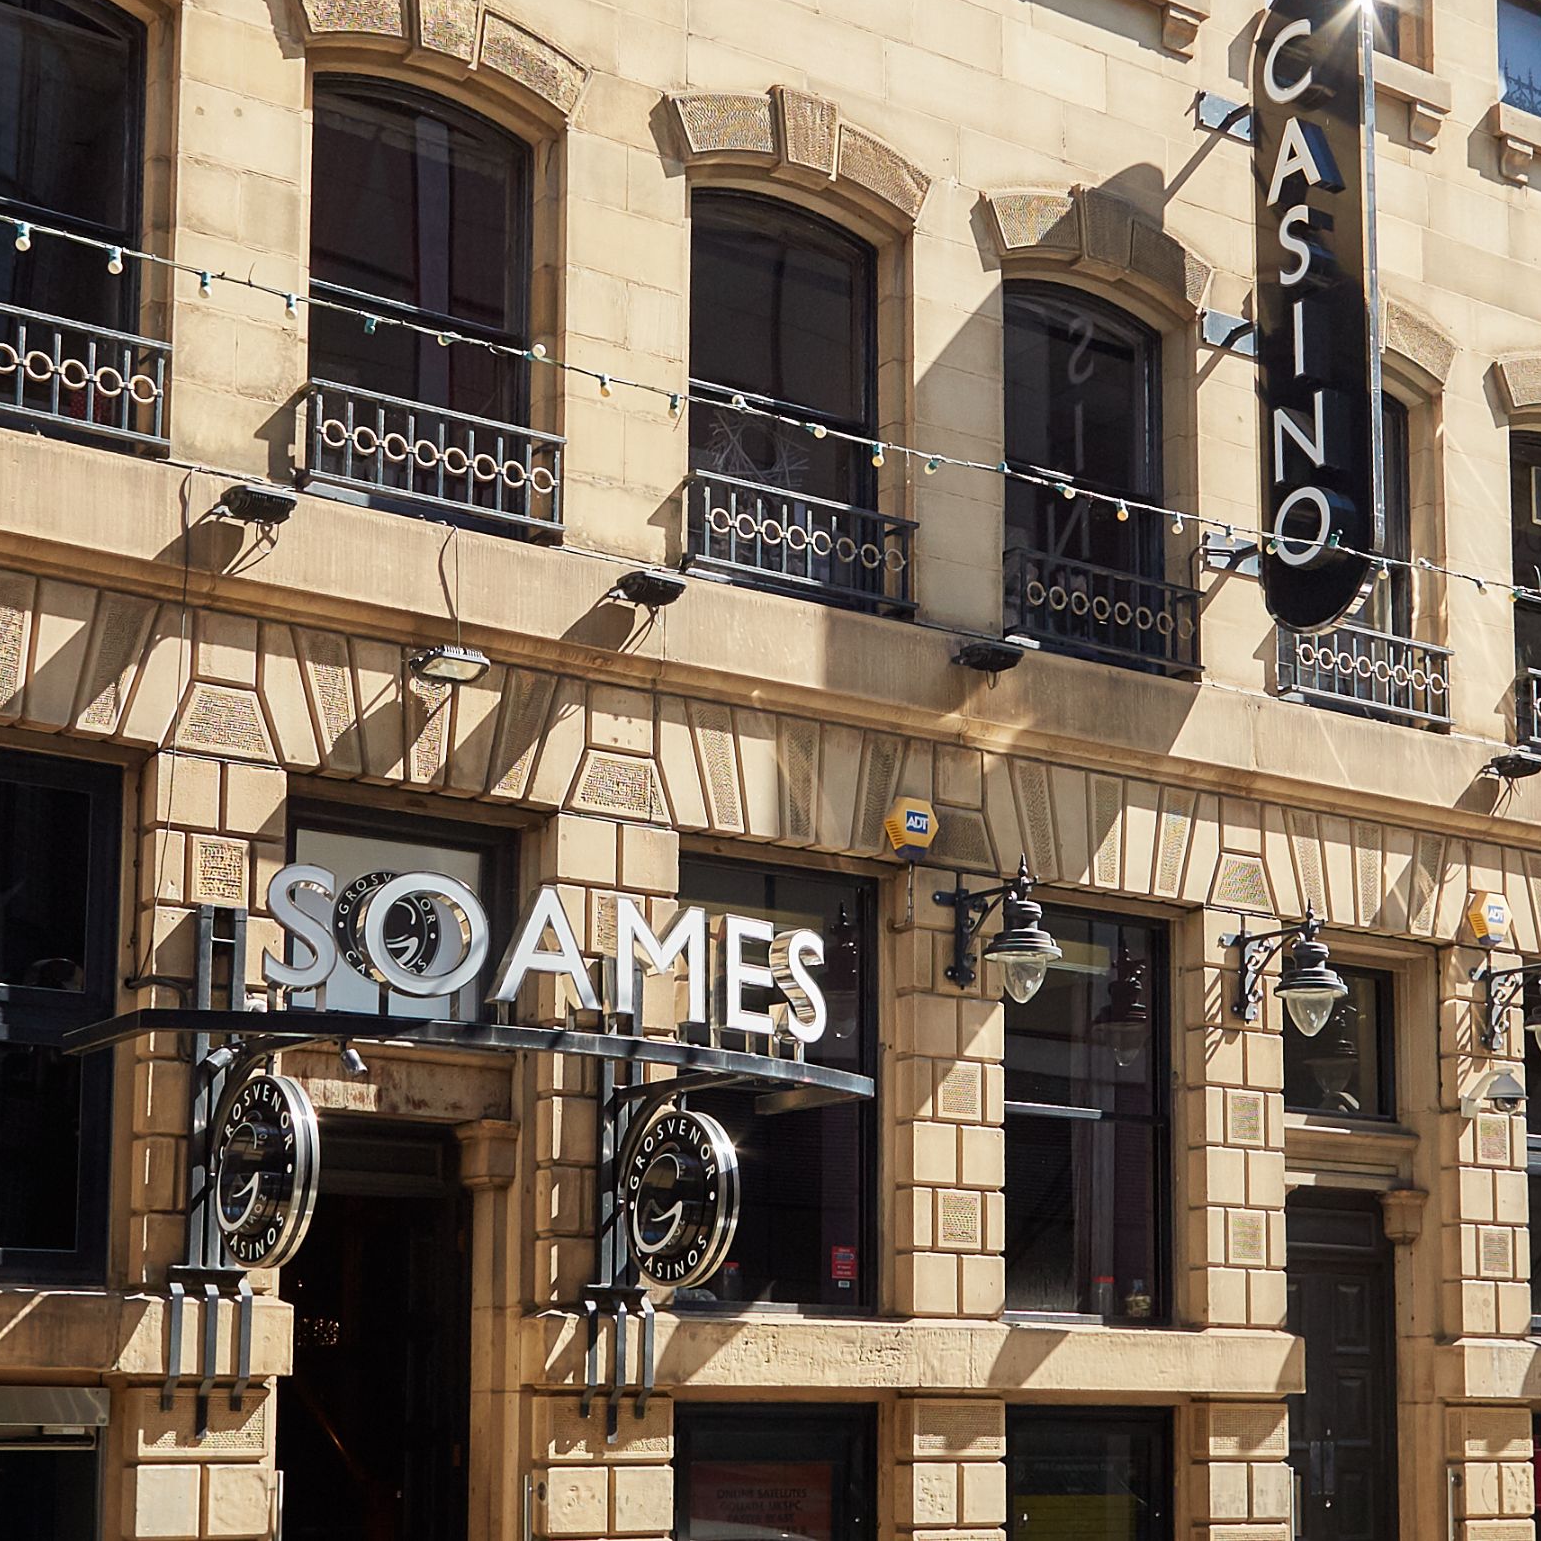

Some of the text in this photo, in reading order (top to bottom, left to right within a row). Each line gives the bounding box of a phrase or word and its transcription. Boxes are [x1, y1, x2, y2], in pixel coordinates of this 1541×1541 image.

[1262, 17, 1334, 569] CASINO
[906, 815, 929, 831] ADT
[338, 872, 436, 925] GROSVOR
[261, 861, 828, 1044] SOAMES
[629, 1118, 716, 1191] GROSVENOR
[224, 1211, 285, 1260] ASINOS
